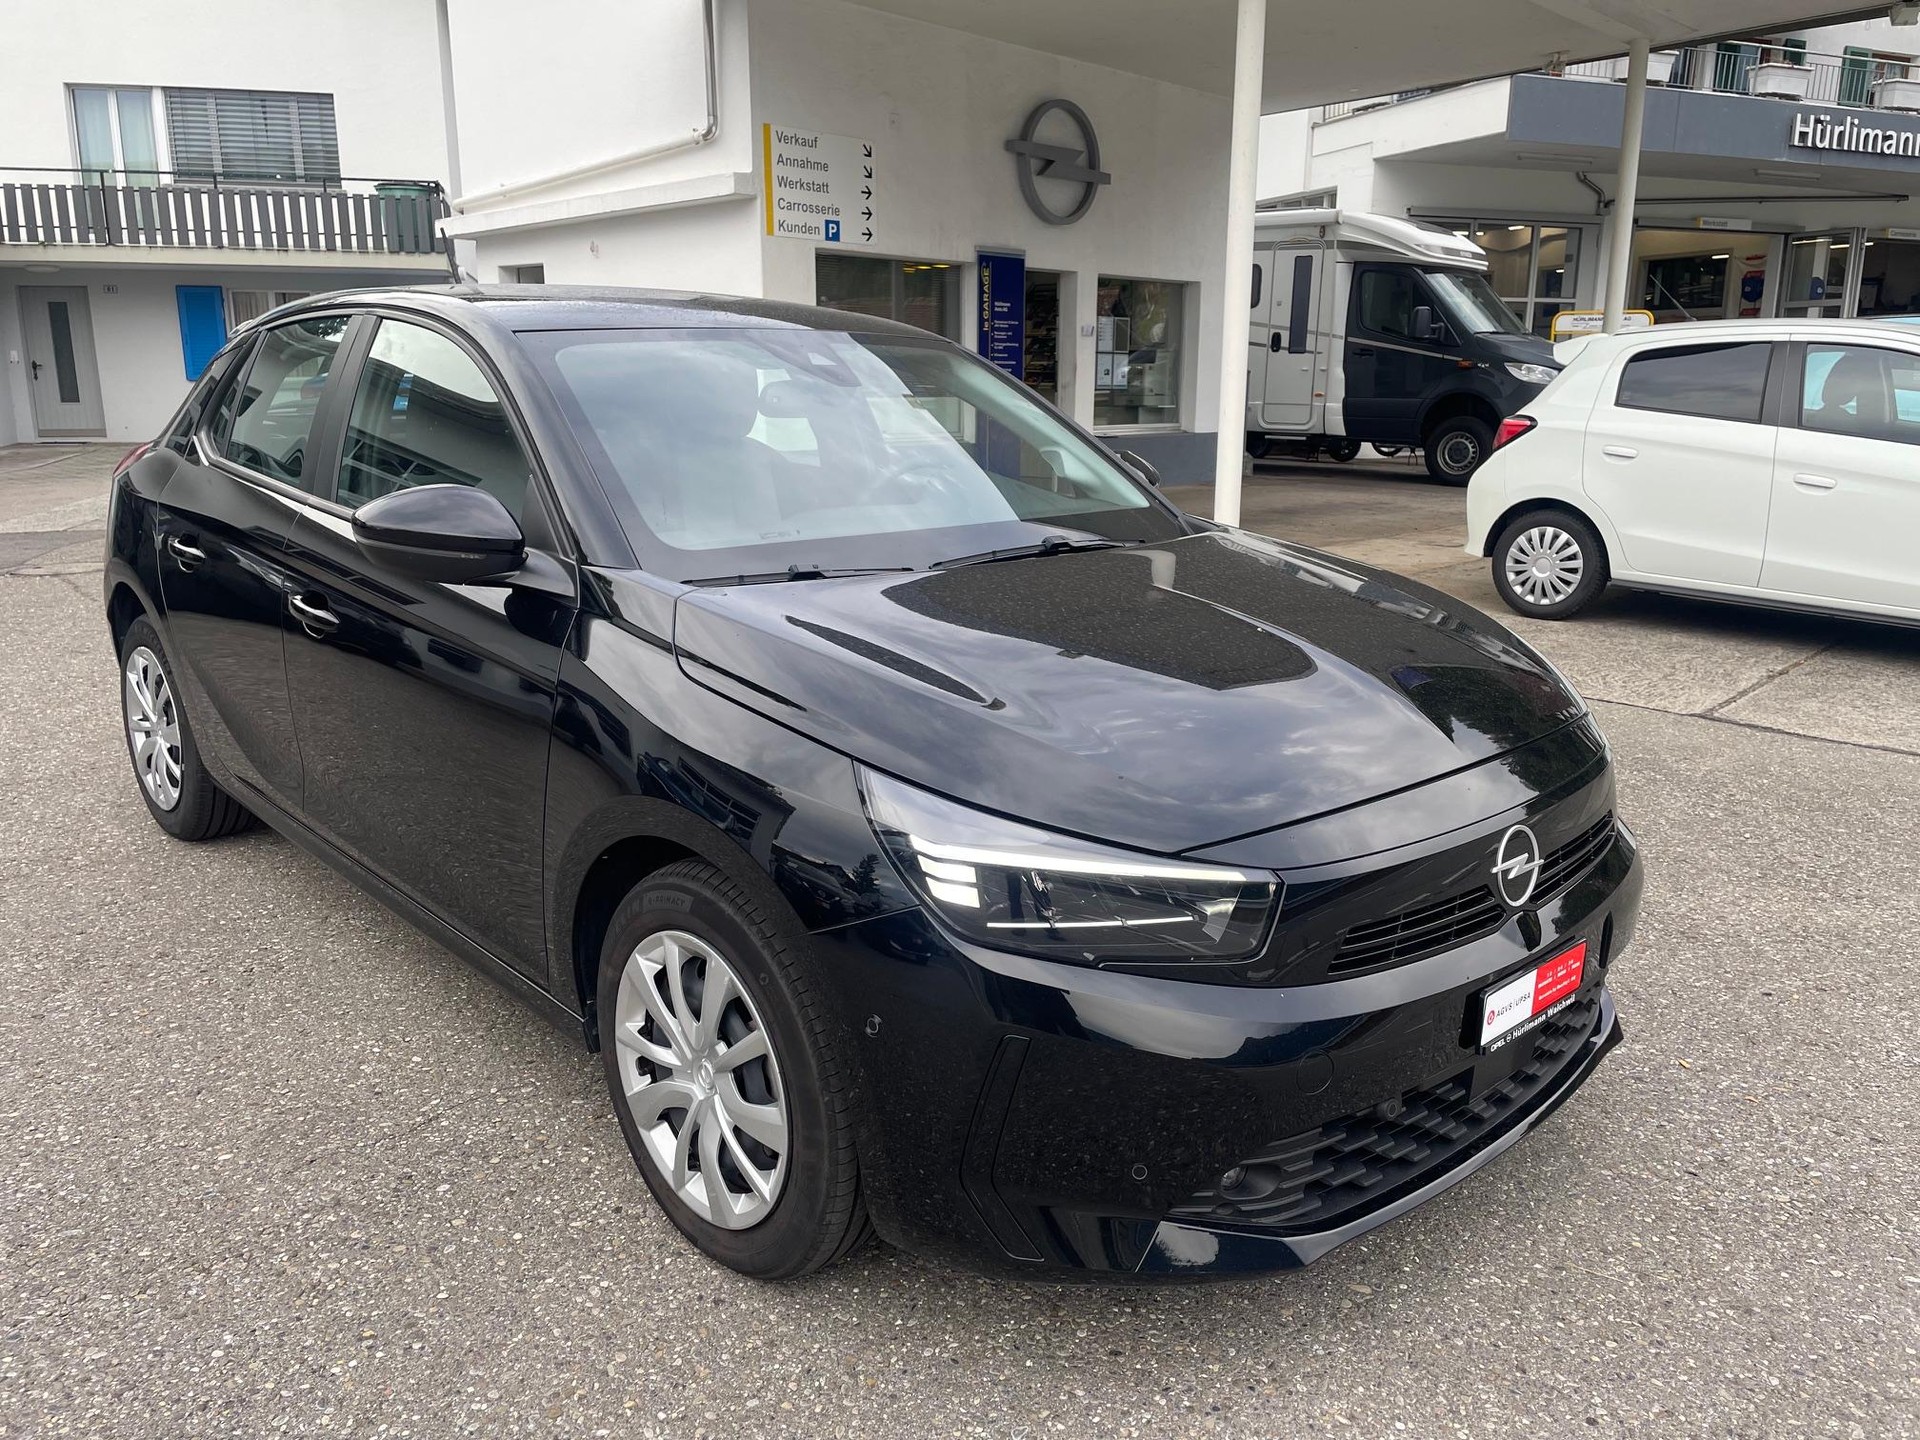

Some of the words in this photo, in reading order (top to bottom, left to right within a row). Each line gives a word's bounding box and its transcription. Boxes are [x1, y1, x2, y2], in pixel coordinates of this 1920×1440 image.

[776, 130, 819, 149] Verkauf
[777, 153, 829, 172] Annahme
[777, 175, 830, 194] Werkstatt
[777, 197, 840, 217] Carrosserie
[778, 220, 820, 235] Kunden
[828, 223, 837, 238] P
[1496, 1002, 1513, 1017] AGVS
[1515, 992, 1531, 1007] UPSA
[1490, 1039, 1506, 1052] OPEL
[1512, 1013, 1546, 1040] Hürlimann
